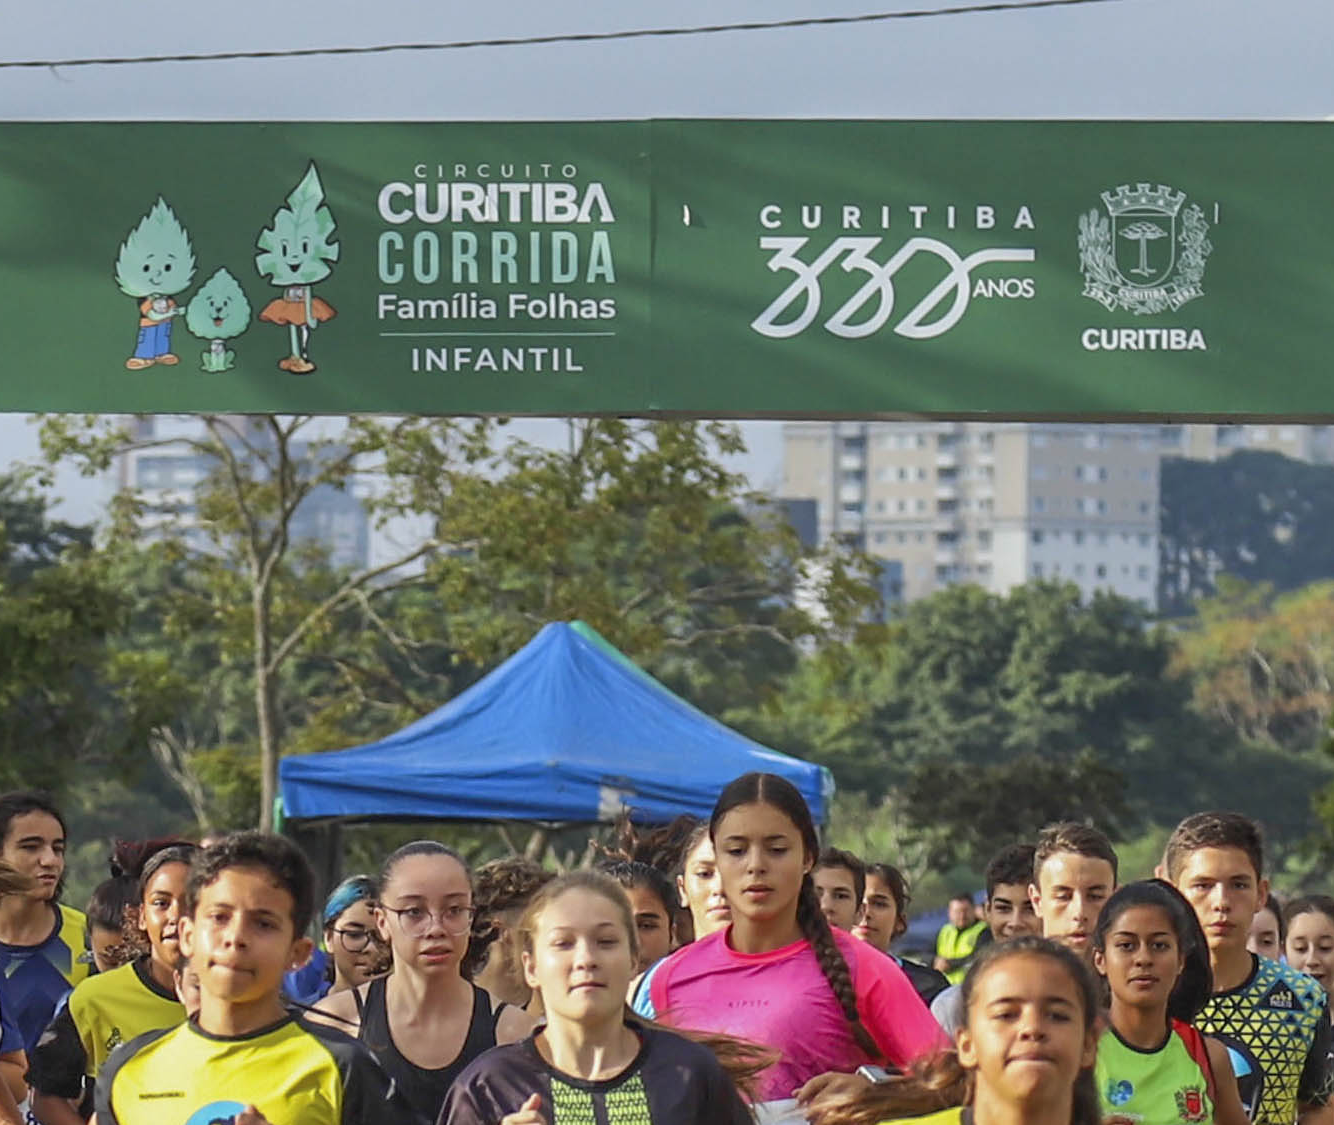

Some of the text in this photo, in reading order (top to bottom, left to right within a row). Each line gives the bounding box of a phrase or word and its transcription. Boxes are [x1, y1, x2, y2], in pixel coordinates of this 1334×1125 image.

[415, 163, 578, 179] CIRCUITO
[377, 183, 616, 224] CURITIBA
[760, 205, 1034, 230] CURITIBA
[379, 230, 616, 284] CORRIDA
[972, 278, 1035, 299] ANOS
[377, 292, 616, 321] Família Folhas
[1081, 328, 1207, 351] CURITIBA
[411, 348, 583, 372] INFANTIL
